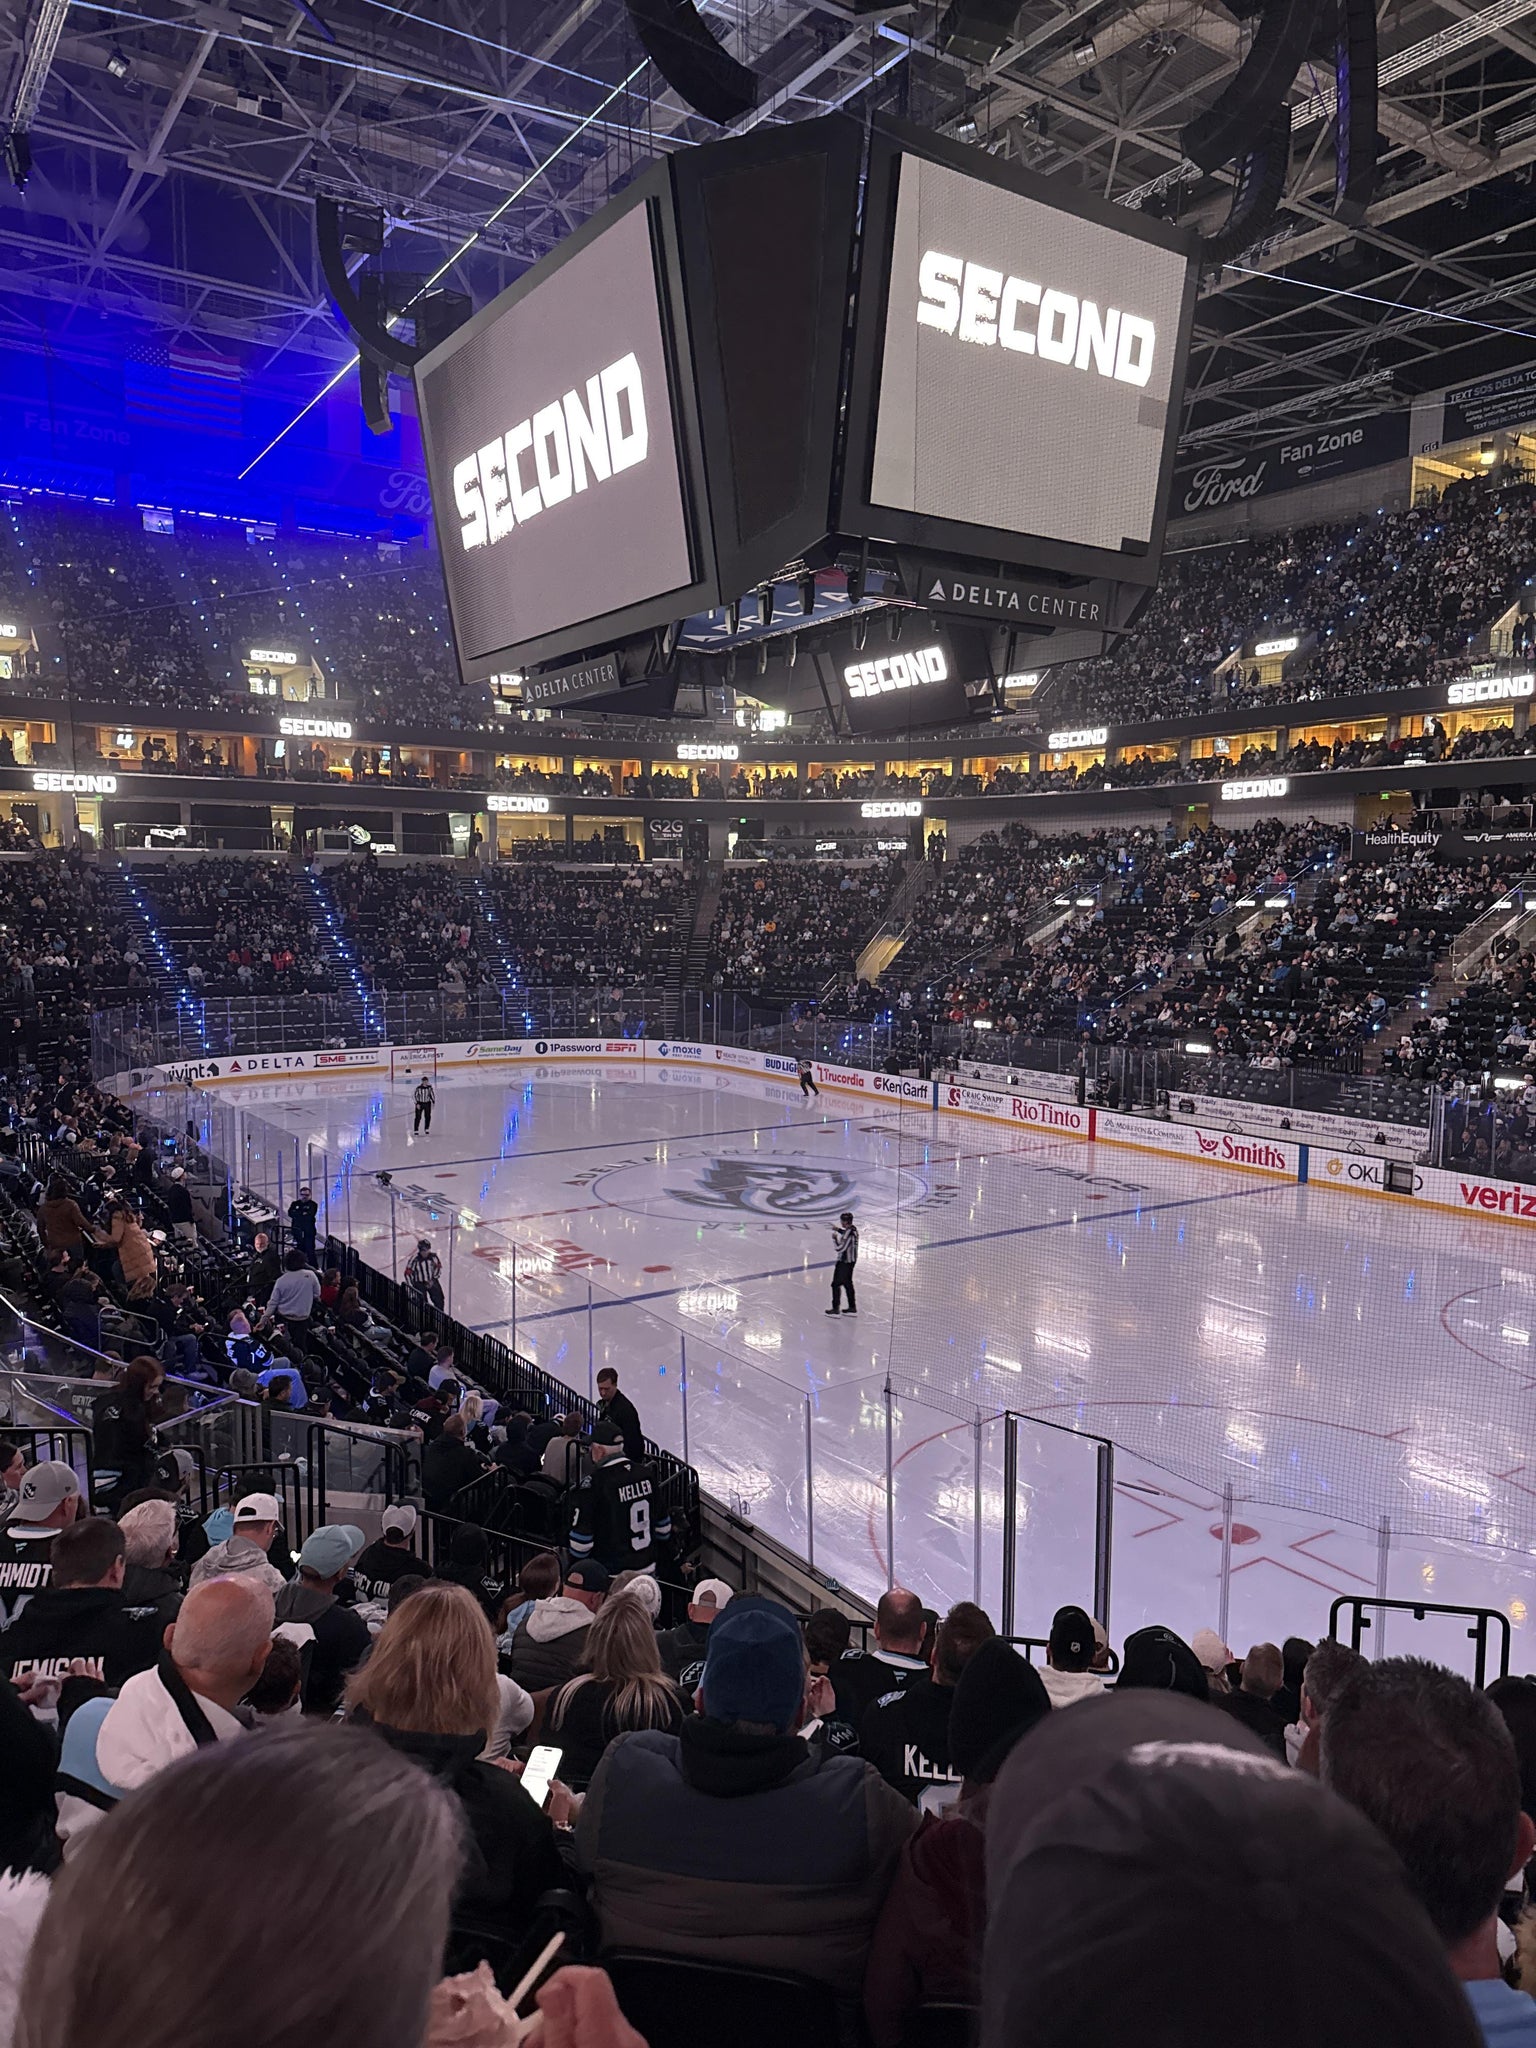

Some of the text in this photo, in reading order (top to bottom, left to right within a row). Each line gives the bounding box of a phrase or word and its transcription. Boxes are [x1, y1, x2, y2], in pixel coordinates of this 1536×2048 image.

[917, 251, 1156, 387] SECOND
[1450, 389, 1473, 404] TEXT
[1473, 383, 1493, 396] SOS
[1495, 375, 1523, 390] DELTA
[24, 412, 131, 446] Fan Zone
[453, 351, 649, 551] SECOND
[1280, 426, 1364, 464] Fan Zone
[379, 471, 433, 515] Fo
[1184, 457, 1268, 512] Ford
[952, 582, 1098, 622] DELTA CENTER
[250, 649, 297, 664] SECOND
[535, 664, 615, 700] DELTA CENTER
[844, 646, 947, 698] SECOND
[1448, 675, 1535, 704] SECOND
[280, 718, 352, 738] SECOND
[1049, 728, 1107, 749] SECOND
[677, 744, 739, 760] SECOND
[33, 773, 117, 793] SECOND
[1221, 778, 1288, 800] SECOND
[487, 796, 550, 813] SECOND
[861, 801, 922, 818] SECOND
[650, 819, 684, 833] G2G
[1365, 831, 1440, 848] HealthEquity
[480, 1044, 522, 1053] SameDay
[550, 1042, 602, 1054] 1Password
[606, 1042, 637, 1053] ESPN
[672, 1045, 702, 1056] moxie
[248, 1057, 305, 1070] DELTA
[320, 1055, 346, 1064] SME
[765, 1058, 781, 1069] BUD
[824, 1067, 864, 1088] Trucordia
[882, 1078, 928, 1100] Ken Garff
[962, 1089, 1004, 1104] CRAIG SWAPP
[1011, 1098, 1081, 1129] Rio Tinto
[1116, 1122, 1147, 1134] MORETON
[1153, 1128, 1185, 1141] COMPANY
[1221, 1135, 1286, 1170] Smith's
[574, 1156, 657, 1180] DELTA
[1035, 1166, 1150, 1192] PACS
[1348, 1162, 1424, 1191] OKLD
[618, 1479, 653, 1502] KELLER
[630, 1499, 652, 1551] 9
[0, 1562, 53, 1588] HMIDT
[904, 1743, 965, 1783] KELL
